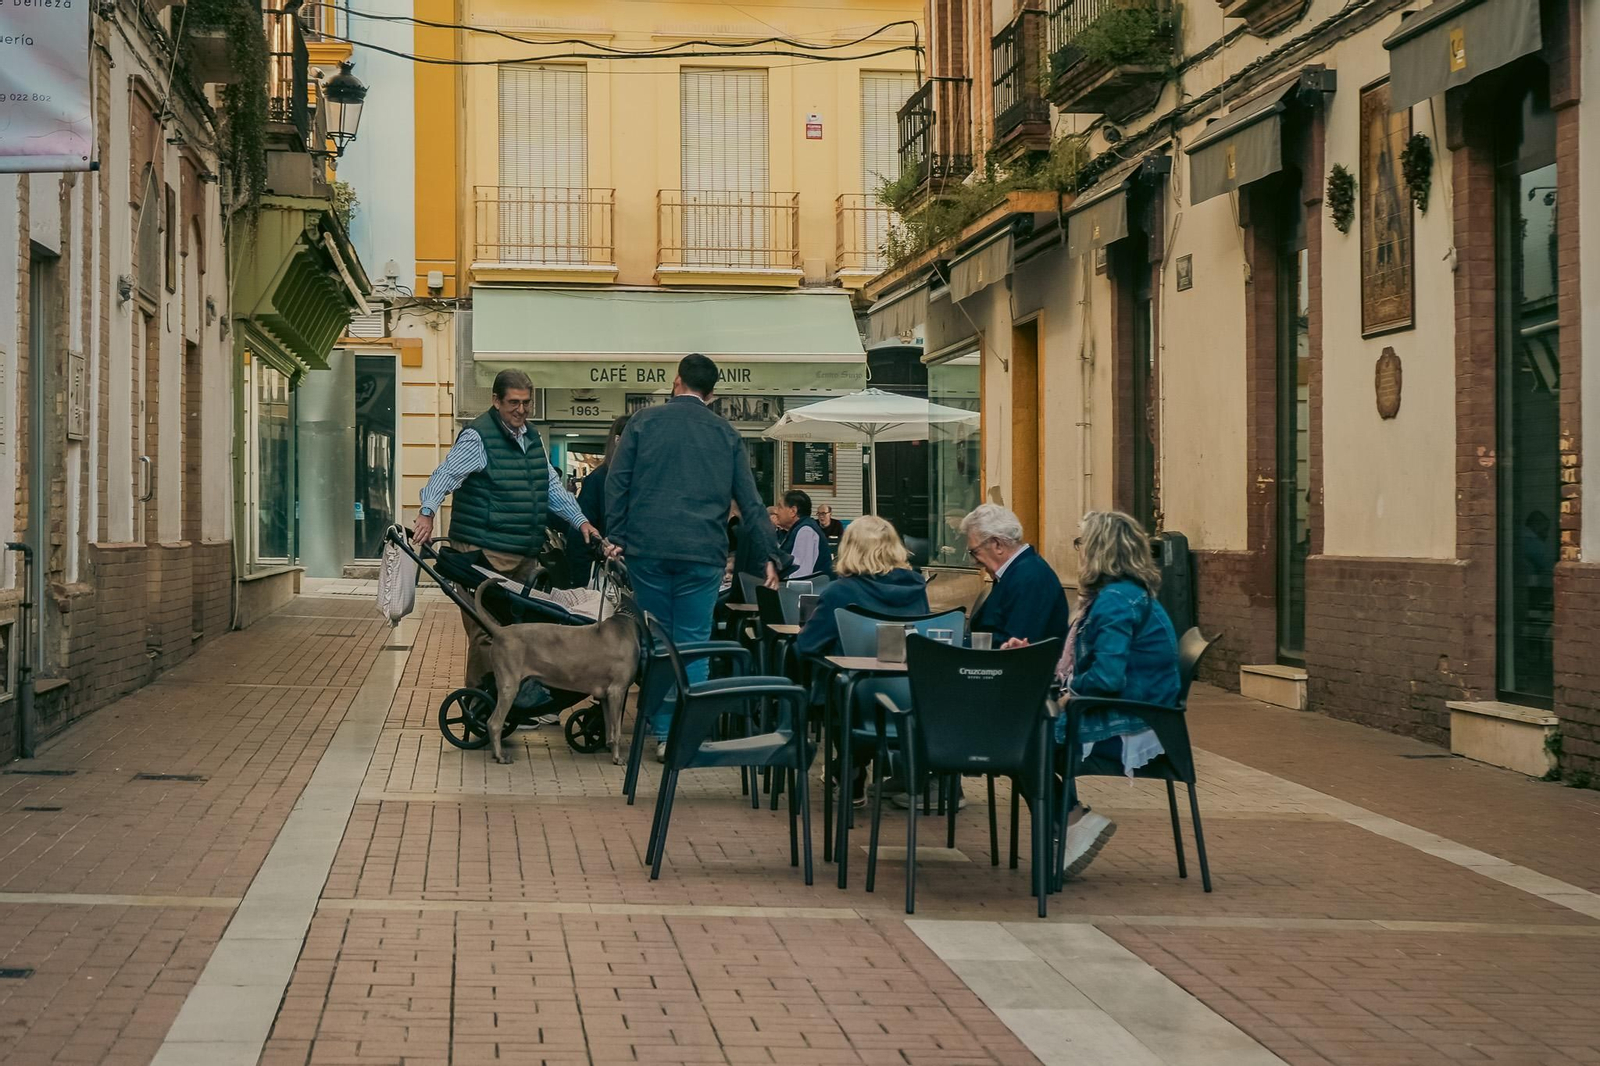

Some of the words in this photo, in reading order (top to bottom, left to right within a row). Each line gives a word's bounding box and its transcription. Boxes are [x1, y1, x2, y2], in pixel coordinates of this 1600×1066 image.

[9, 93, 28, 101] 022
[32, 93, 51, 101] 802
[590, 364, 627, 382] CAFÉ
[636, 368, 666, 382] BAR
[716, 368, 751, 382] ANIR
[569, 406, 600, 416] 1963
[959, 667, 1003, 676] Cruzcampo
